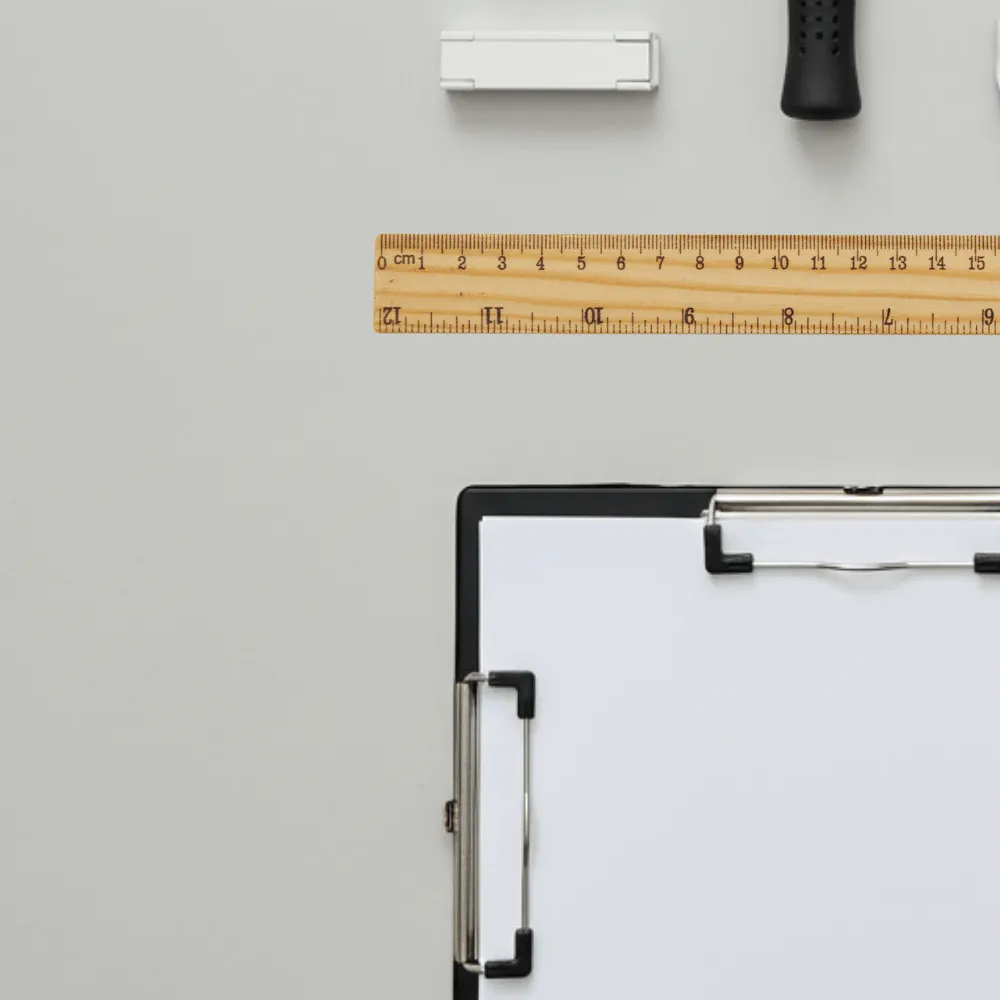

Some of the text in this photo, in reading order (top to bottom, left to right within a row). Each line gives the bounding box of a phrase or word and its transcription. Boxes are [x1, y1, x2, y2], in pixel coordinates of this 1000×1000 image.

[377, 255, 387, 270] 0
[394, 253, 416, 265] cm
[418, 255, 426, 270] 1
[458, 255, 467, 270] 2
[497, 255, 507, 270] 3
[536, 255, 545, 270] 4
[577, 255, 586, 270] 5
[616, 255, 626, 270] 6
[655, 255, 665, 270] 7
[695, 255, 705, 270] 8
[735, 255, 745, 270] 9
[771, 255, 789, 270] 10
[811, 255, 827, 270] 11
[850, 255, 868, 270] 12
[889, 255, 907, 270] 13
[928, 255, 946, 270] 14
[968, 255, 986, 270] 15
[382, 306, 402, 325] 12
[484, 306, 504, 325] 11
[584, 306, 604, 325] 10
[684, 306, 695, 325] 9
[784, 306, 795, 325] 8
[883, 307, 894, 326] 7
[984, 307, 995, 326] 6
